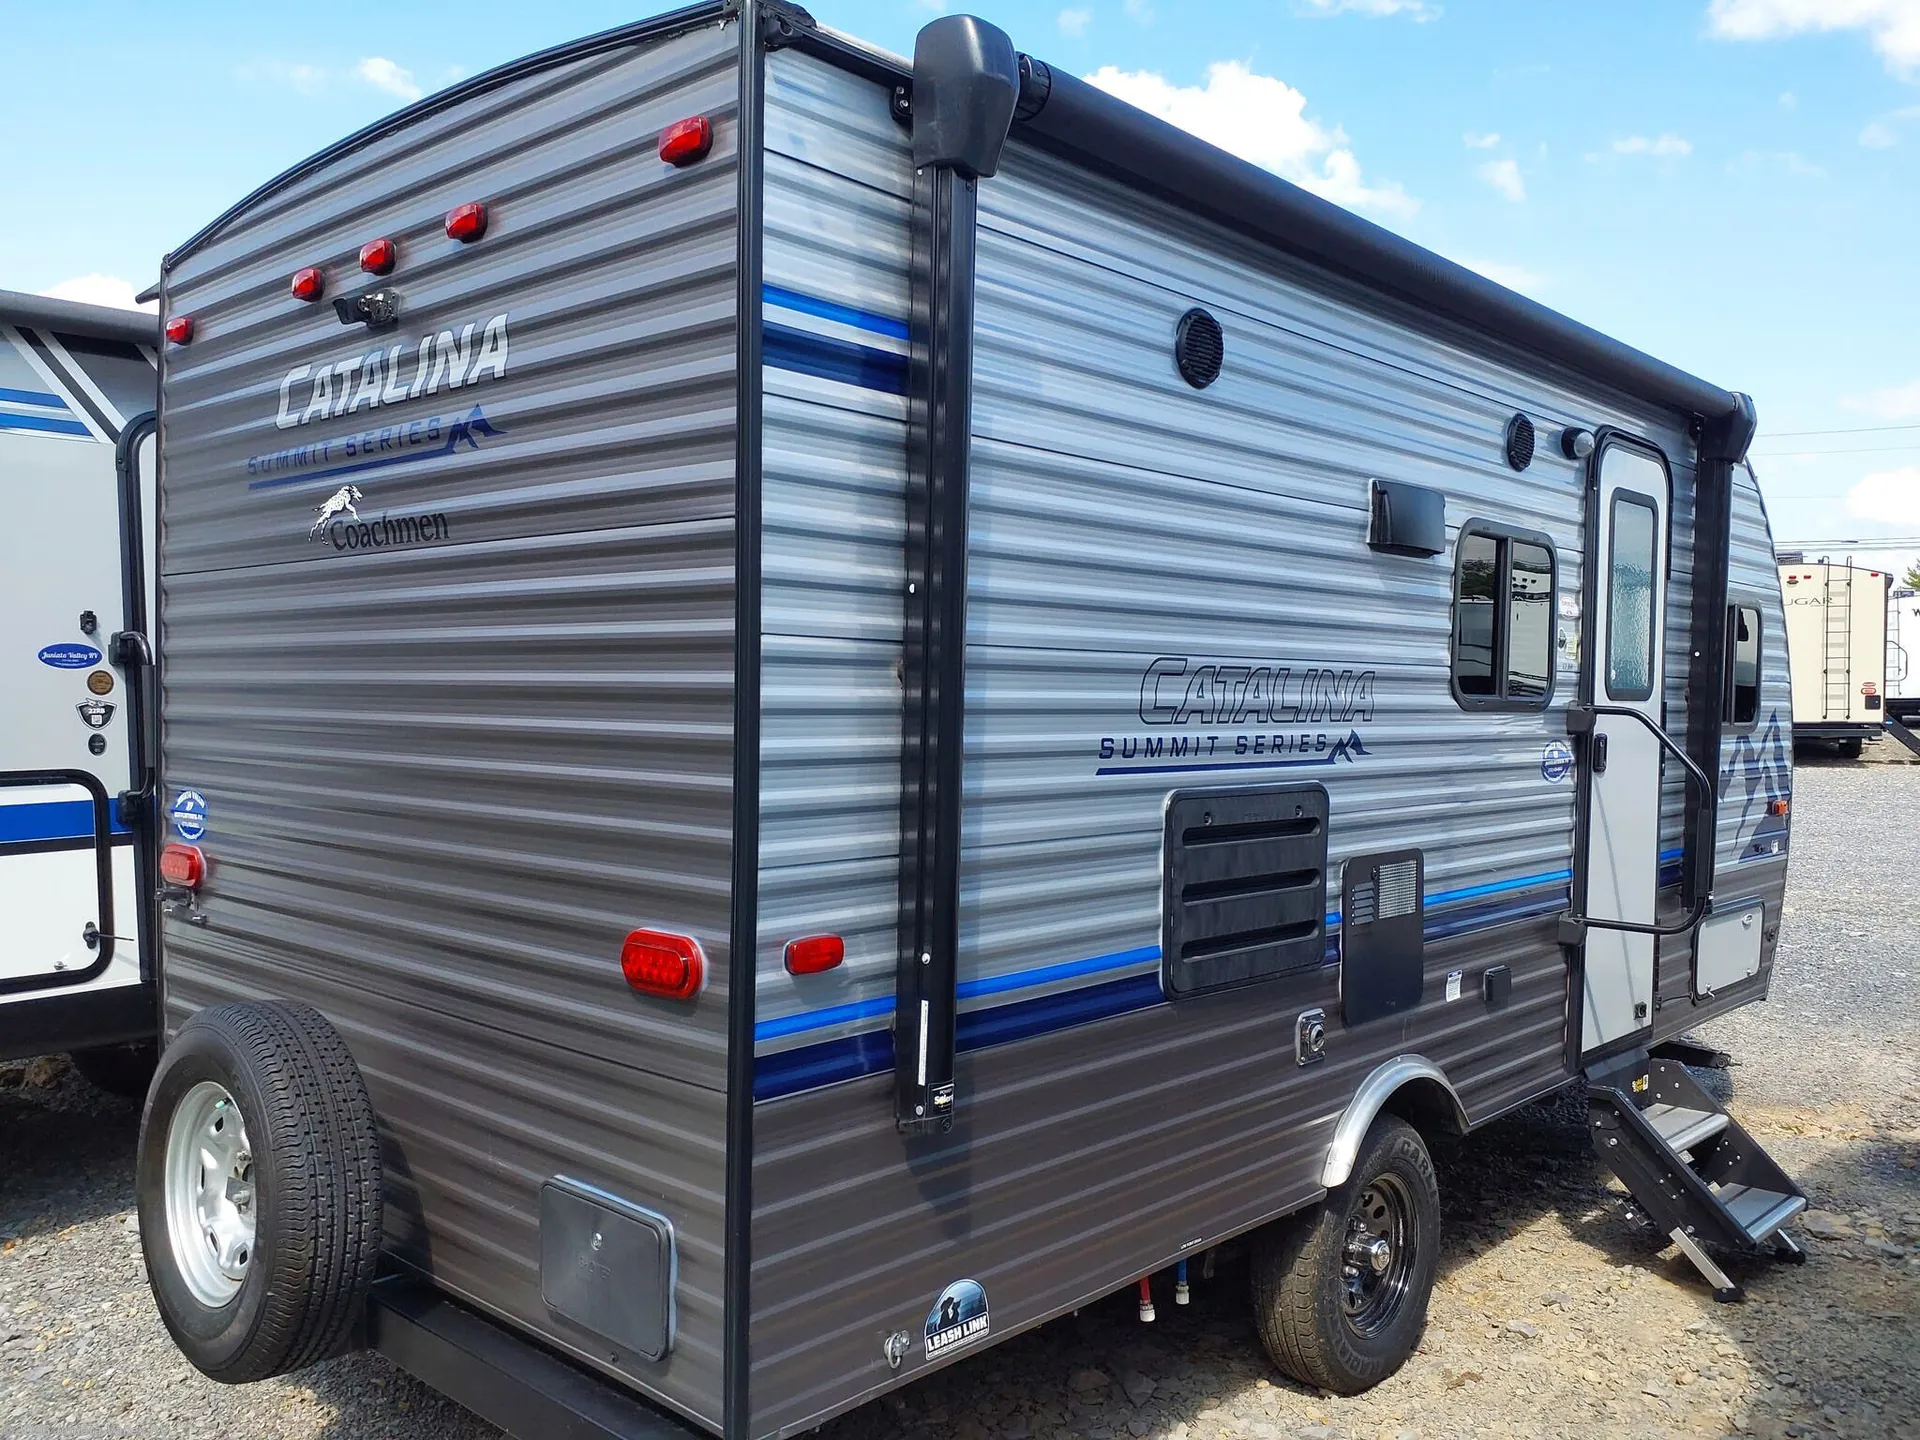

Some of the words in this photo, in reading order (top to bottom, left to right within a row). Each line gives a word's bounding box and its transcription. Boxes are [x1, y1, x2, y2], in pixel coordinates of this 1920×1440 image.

[275, 313, 510, 430] CATALINA
[248, 440, 333, 476] SUMMIT
[346, 416, 442, 458] SERIES
[329, 509, 450, 551] Coachmen
[1139, 657, 1376, 725] CATALINA
[1099, 736, 1219, 759] SUMMIT
[1234, 733, 1328, 756] SERIES
[926, 1324, 962, 1352] LEASH
[962, 1314, 988, 1337] LINK
